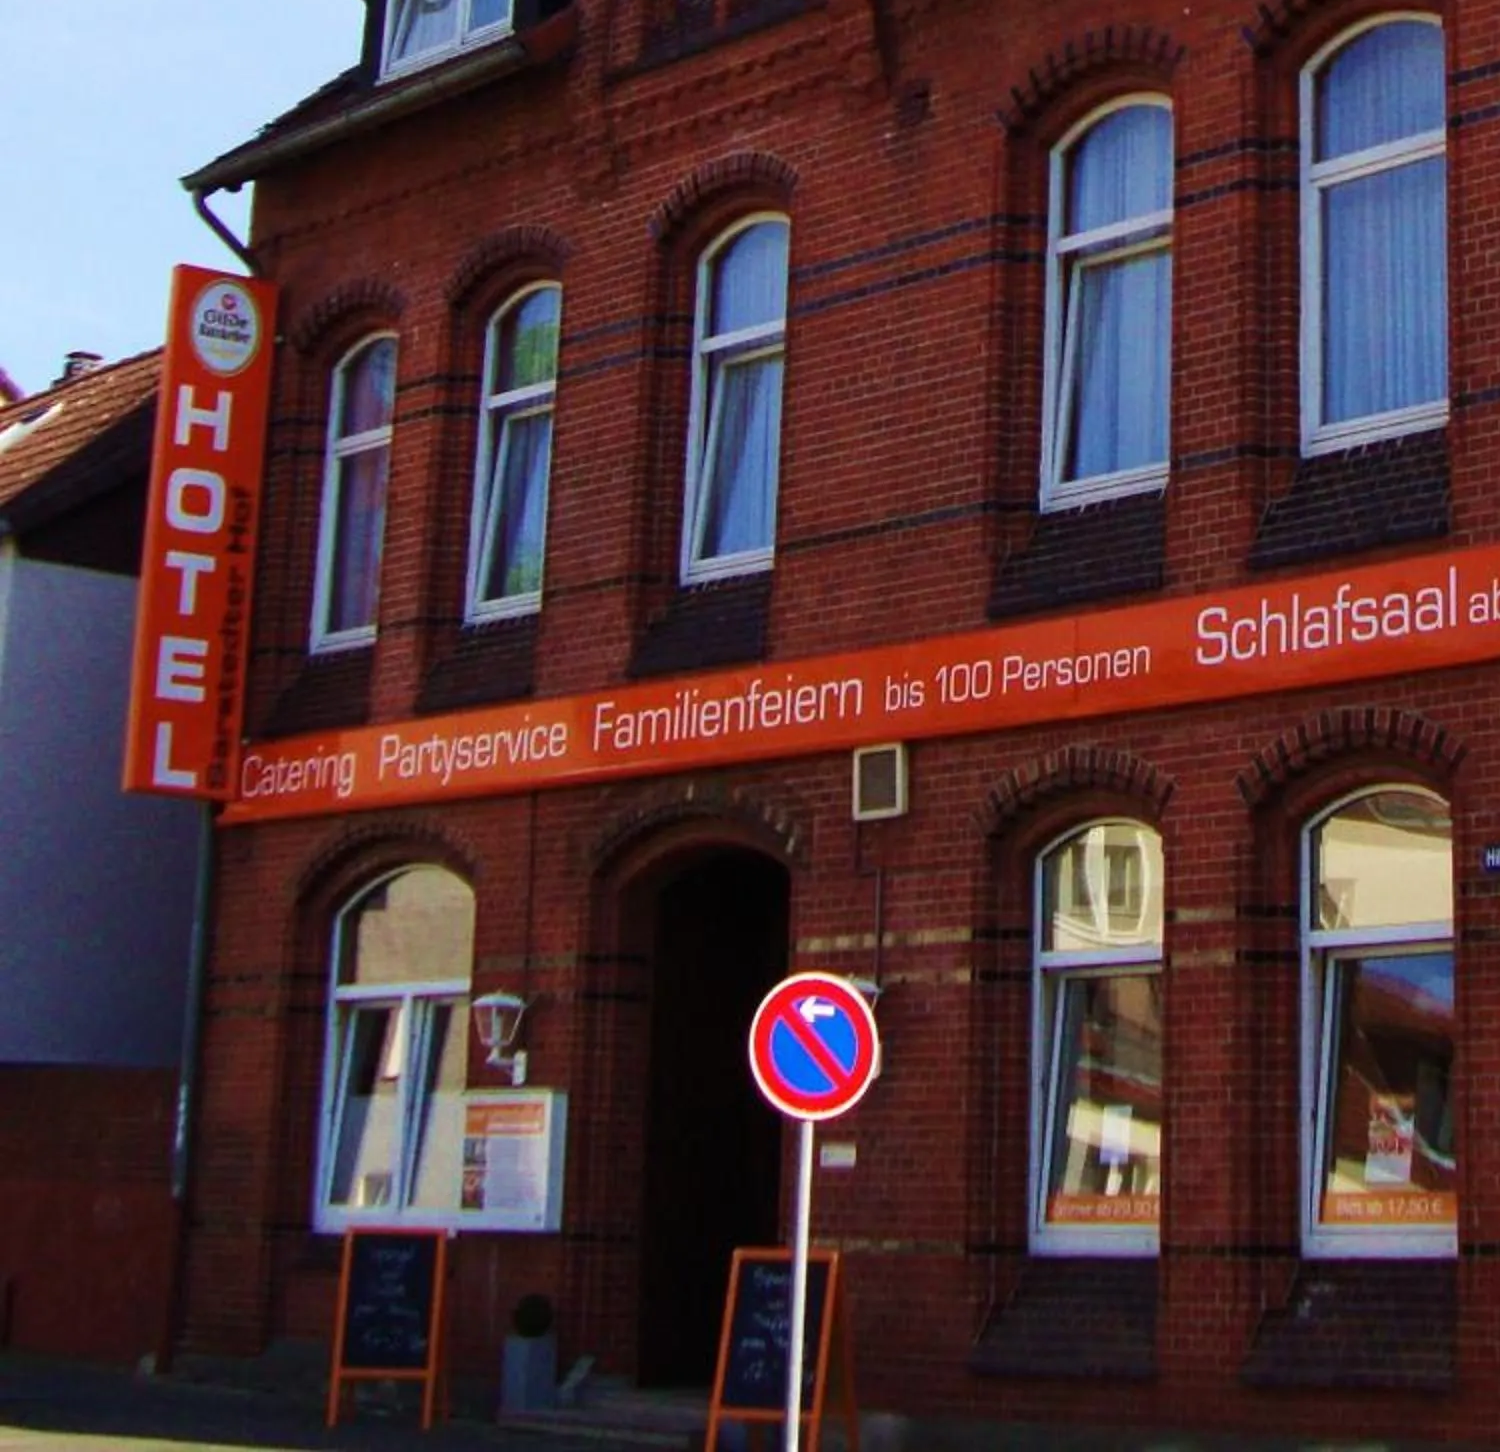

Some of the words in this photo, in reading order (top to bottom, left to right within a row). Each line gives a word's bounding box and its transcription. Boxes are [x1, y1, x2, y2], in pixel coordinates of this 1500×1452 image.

[226, 484, 253, 554] Hof
[152, 384, 233, 789] HOTEL
[1196, 566, 1457, 666] Schlafsaal
[241, 746, 356, 799] Catering
[378, 714, 568, 787] Partyservice
[592, 675, 863, 751] Familienfeiern
[885, 675, 925, 712] bis
[935, 660, 993, 704] 100
[1002, 645, 1151, 695] Personen
